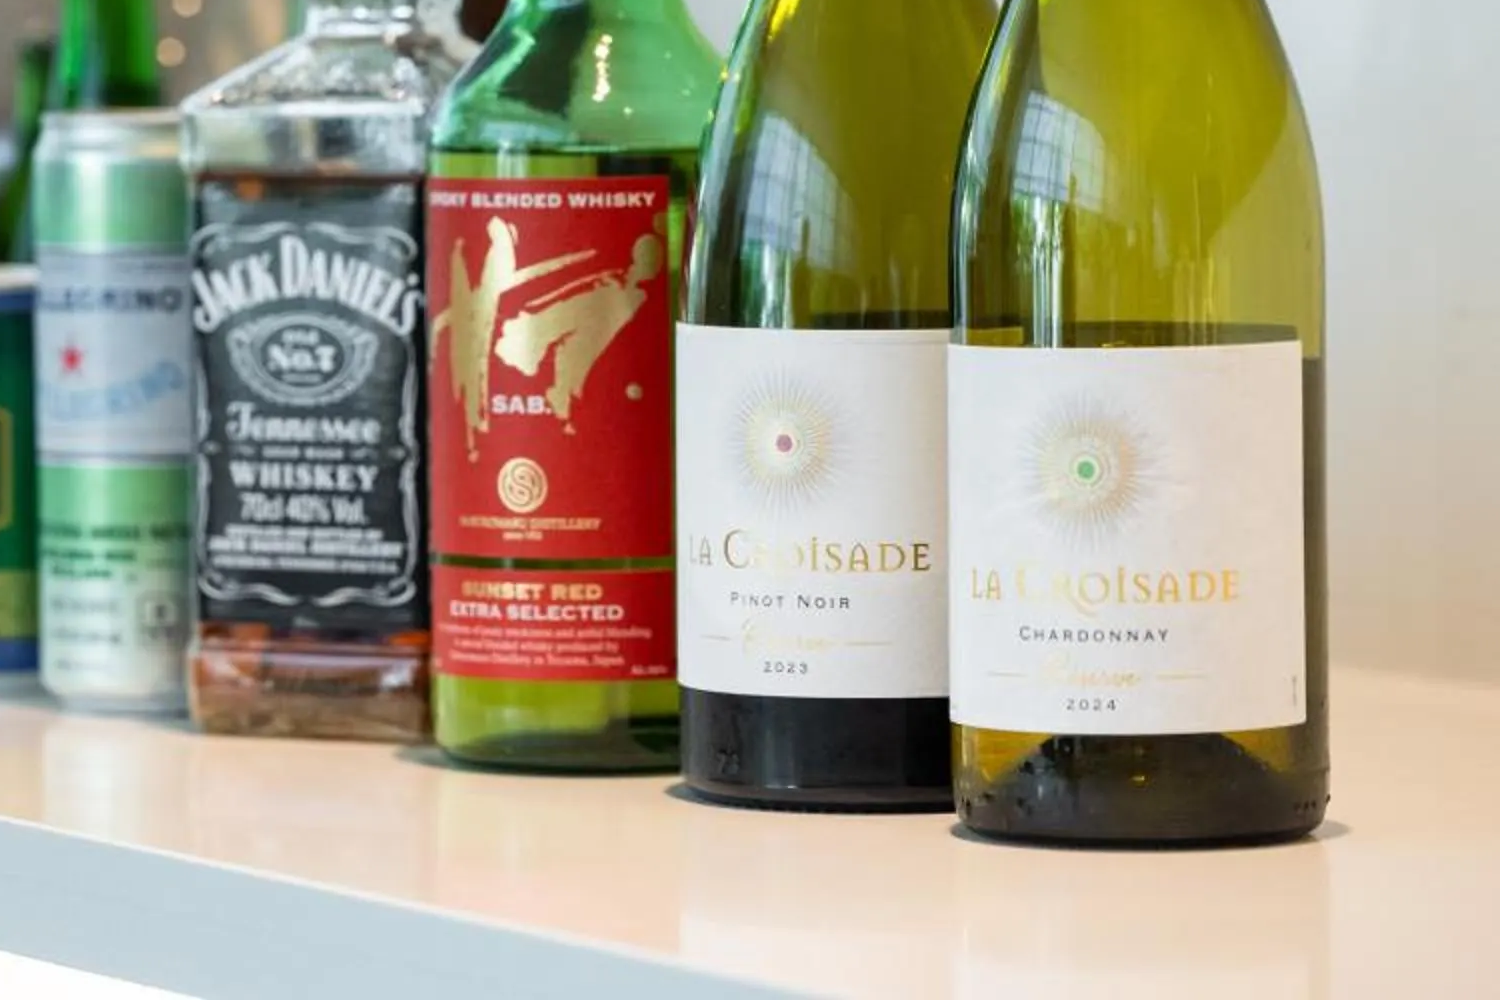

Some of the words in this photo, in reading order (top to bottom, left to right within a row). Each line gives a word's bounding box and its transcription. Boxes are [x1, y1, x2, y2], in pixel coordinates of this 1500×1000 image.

[471, 192, 562, 209] BLENDED
[567, 191, 656, 208] WHISKY
[191, 251, 280, 333] JACK
[279, 234, 425, 337] DANIEL'S
[491, 394, 552, 415] SAB.
[225, 401, 382, 445] Tennessee
[228, 460, 379, 492] WHISKEY
[689, 533, 712, 566] LA
[723, 528, 932, 573] COISADE
[461, 580, 545, 600] SUNSET
[551, 583, 603, 600] RED
[971, 566, 1002, 601] LA
[730, 591, 784, 608] PINOT
[797, 595, 850, 609] NOIR
[450, 600, 502, 619] EXTRA
[505, 604, 625, 622] SELECTED
[1019, 625, 1169, 644] CHARDONNAY
[763, 660, 809, 675] 2023
[1066, 698, 1117, 712] 2024
